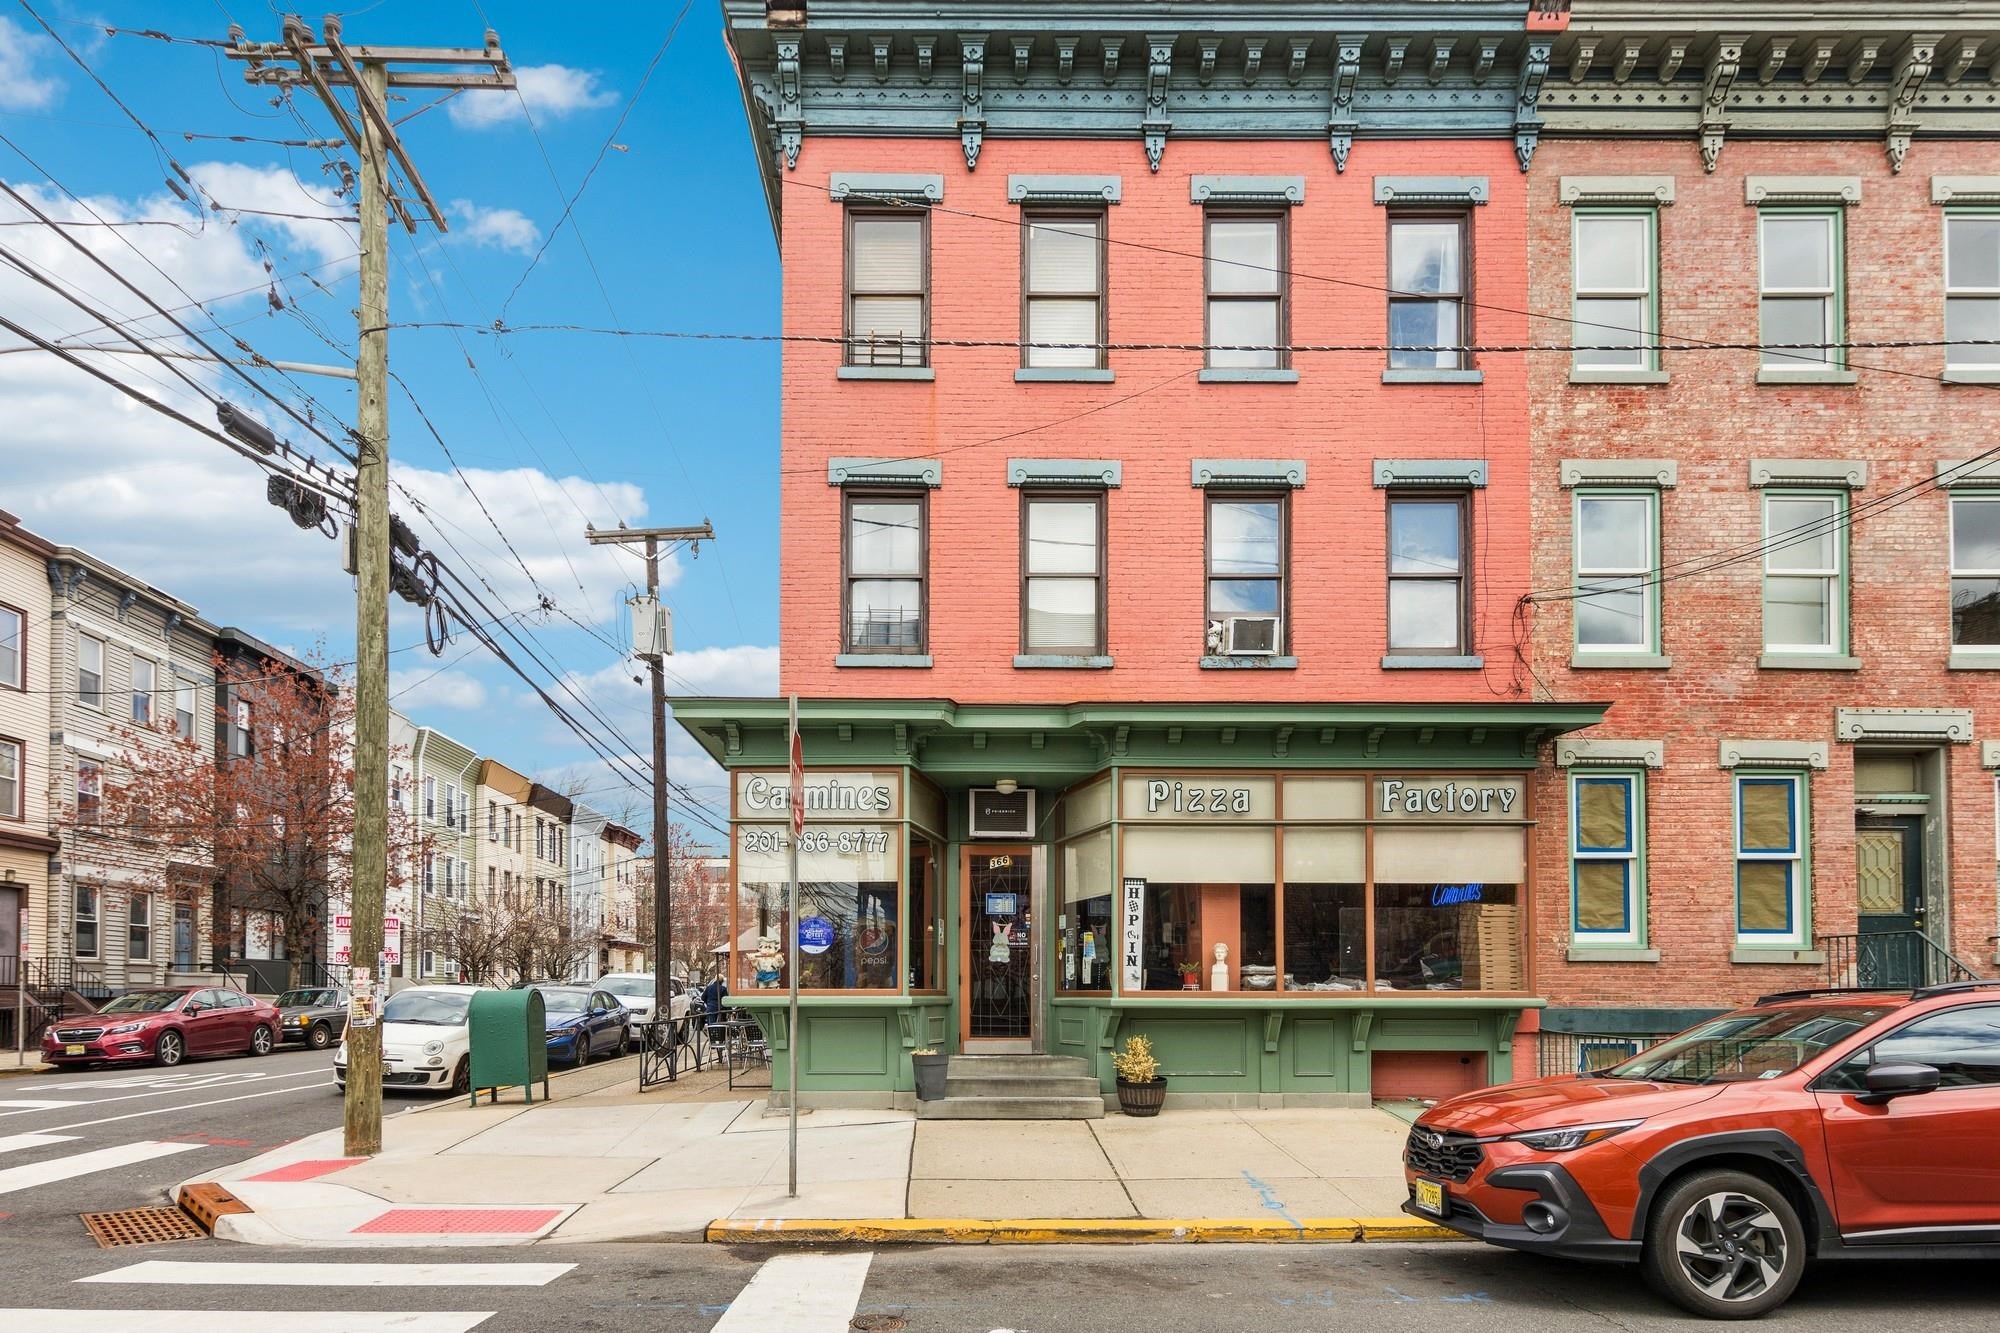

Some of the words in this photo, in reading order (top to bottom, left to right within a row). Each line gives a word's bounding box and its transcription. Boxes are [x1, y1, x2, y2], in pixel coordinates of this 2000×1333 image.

[745, 777, 891, 811] Camines
[1147, 780, 1250, 813] Pizza
[1382, 780, 1516, 813] Factory
[745, 831, 889, 853] 201-86-8777
[991, 856, 1008, 868] 366
[860, 956, 887, 966] pepsi
